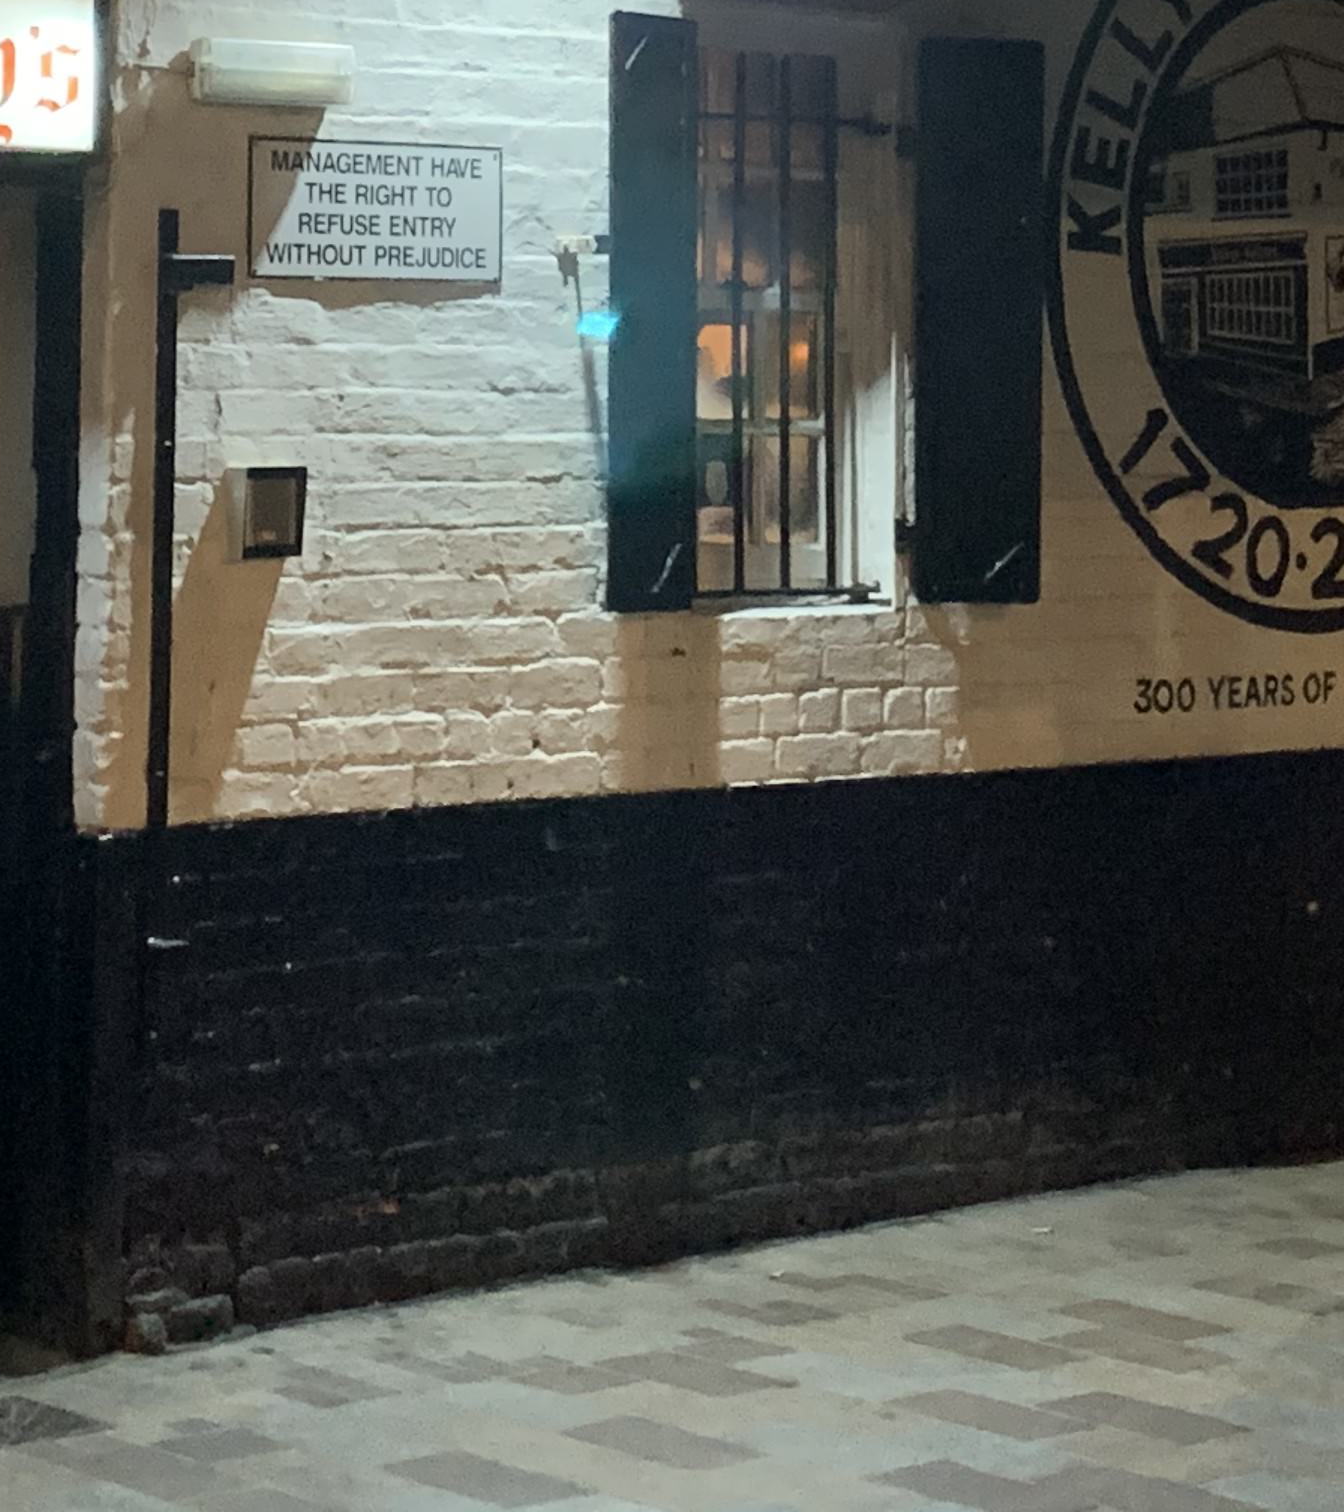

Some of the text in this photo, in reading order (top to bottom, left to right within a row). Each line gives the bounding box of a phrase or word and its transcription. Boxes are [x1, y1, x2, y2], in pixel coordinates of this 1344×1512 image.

[271, 149, 483, 180] MANAGEMENT HAVE
[304, 182, 453, 208] THE RIGHT TO
[297, 212, 457, 237] REFUSE ENTRY
[266, 242, 487, 269] WITHOUT PREJUDICE
[1133, 677, 1196, 714] 300
[1207, 672, 1296, 710] YEARS
[1302, 670, 1337, 705] OF
